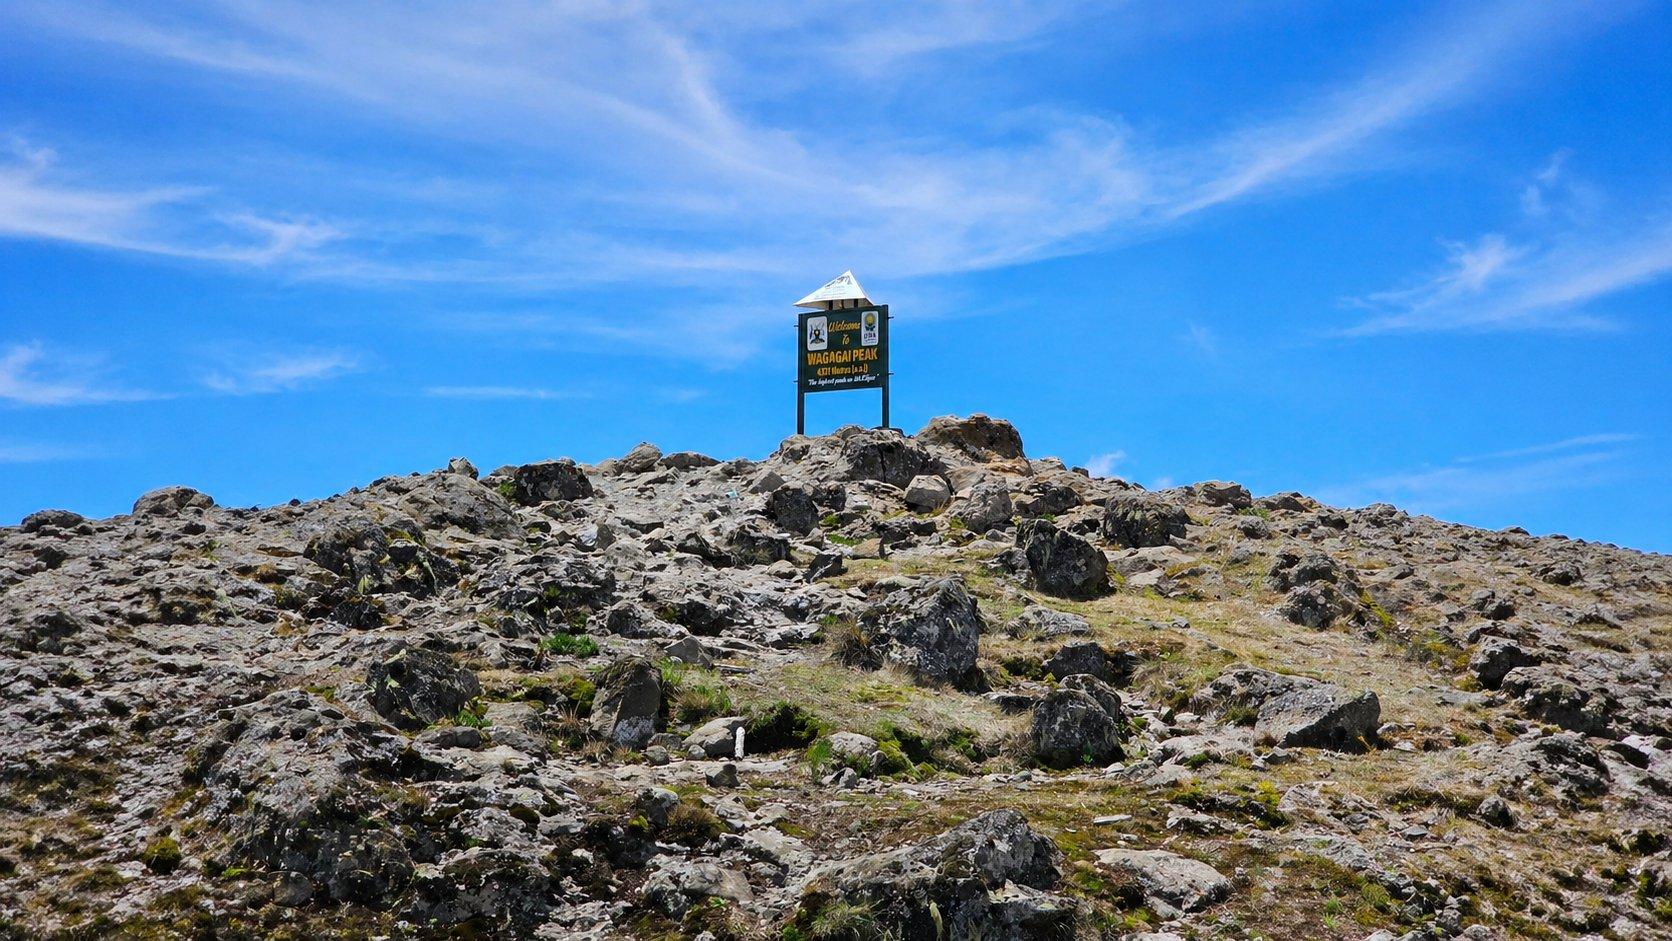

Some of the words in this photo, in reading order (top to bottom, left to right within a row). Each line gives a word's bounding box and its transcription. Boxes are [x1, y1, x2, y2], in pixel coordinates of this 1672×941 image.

[828, 320, 861, 332] Welcome
[807, 351, 851, 366] WAGAGAI
[853, 348, 878, 361] PEAK
